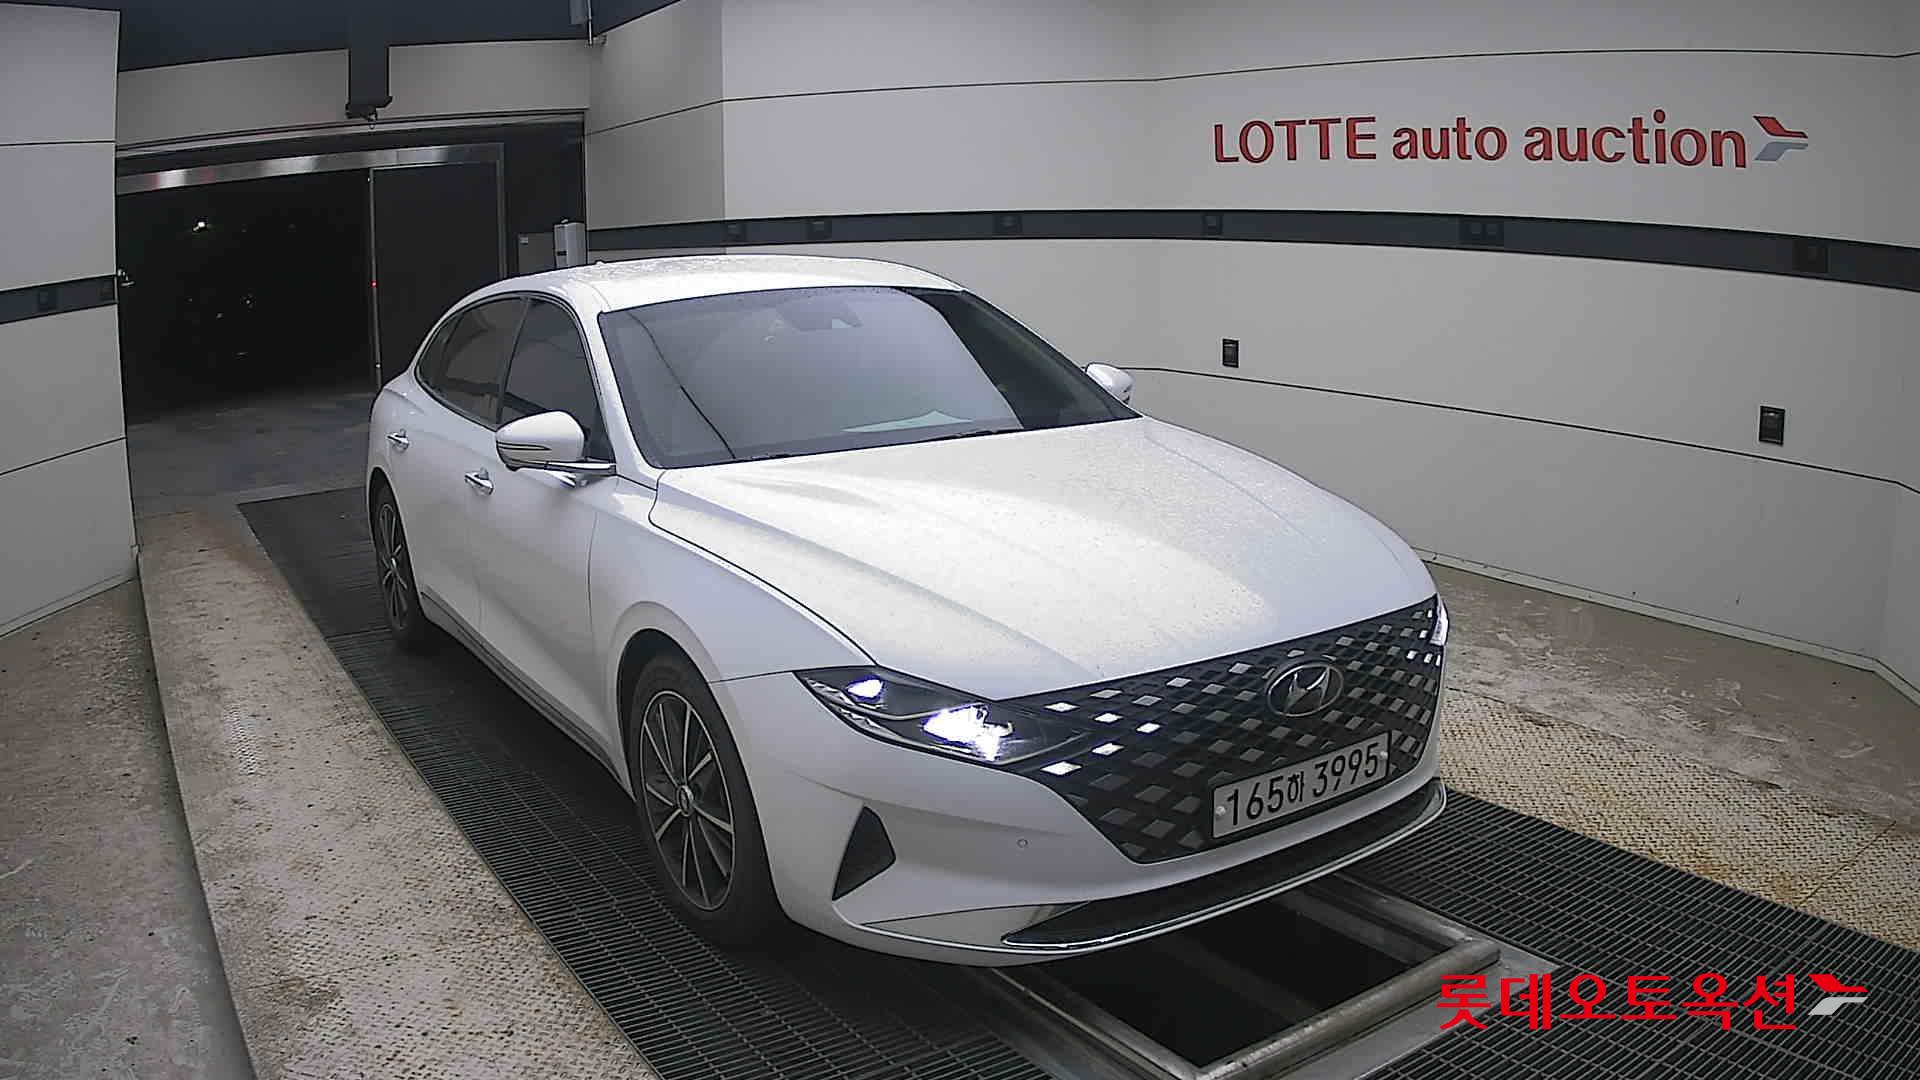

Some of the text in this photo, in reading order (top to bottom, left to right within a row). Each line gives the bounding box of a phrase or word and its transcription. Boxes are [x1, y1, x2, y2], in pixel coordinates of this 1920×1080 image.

[1214, 109, 1747, 169] LOTTE auto auction
[1226, 742, 1380, 826] 165하 3995
